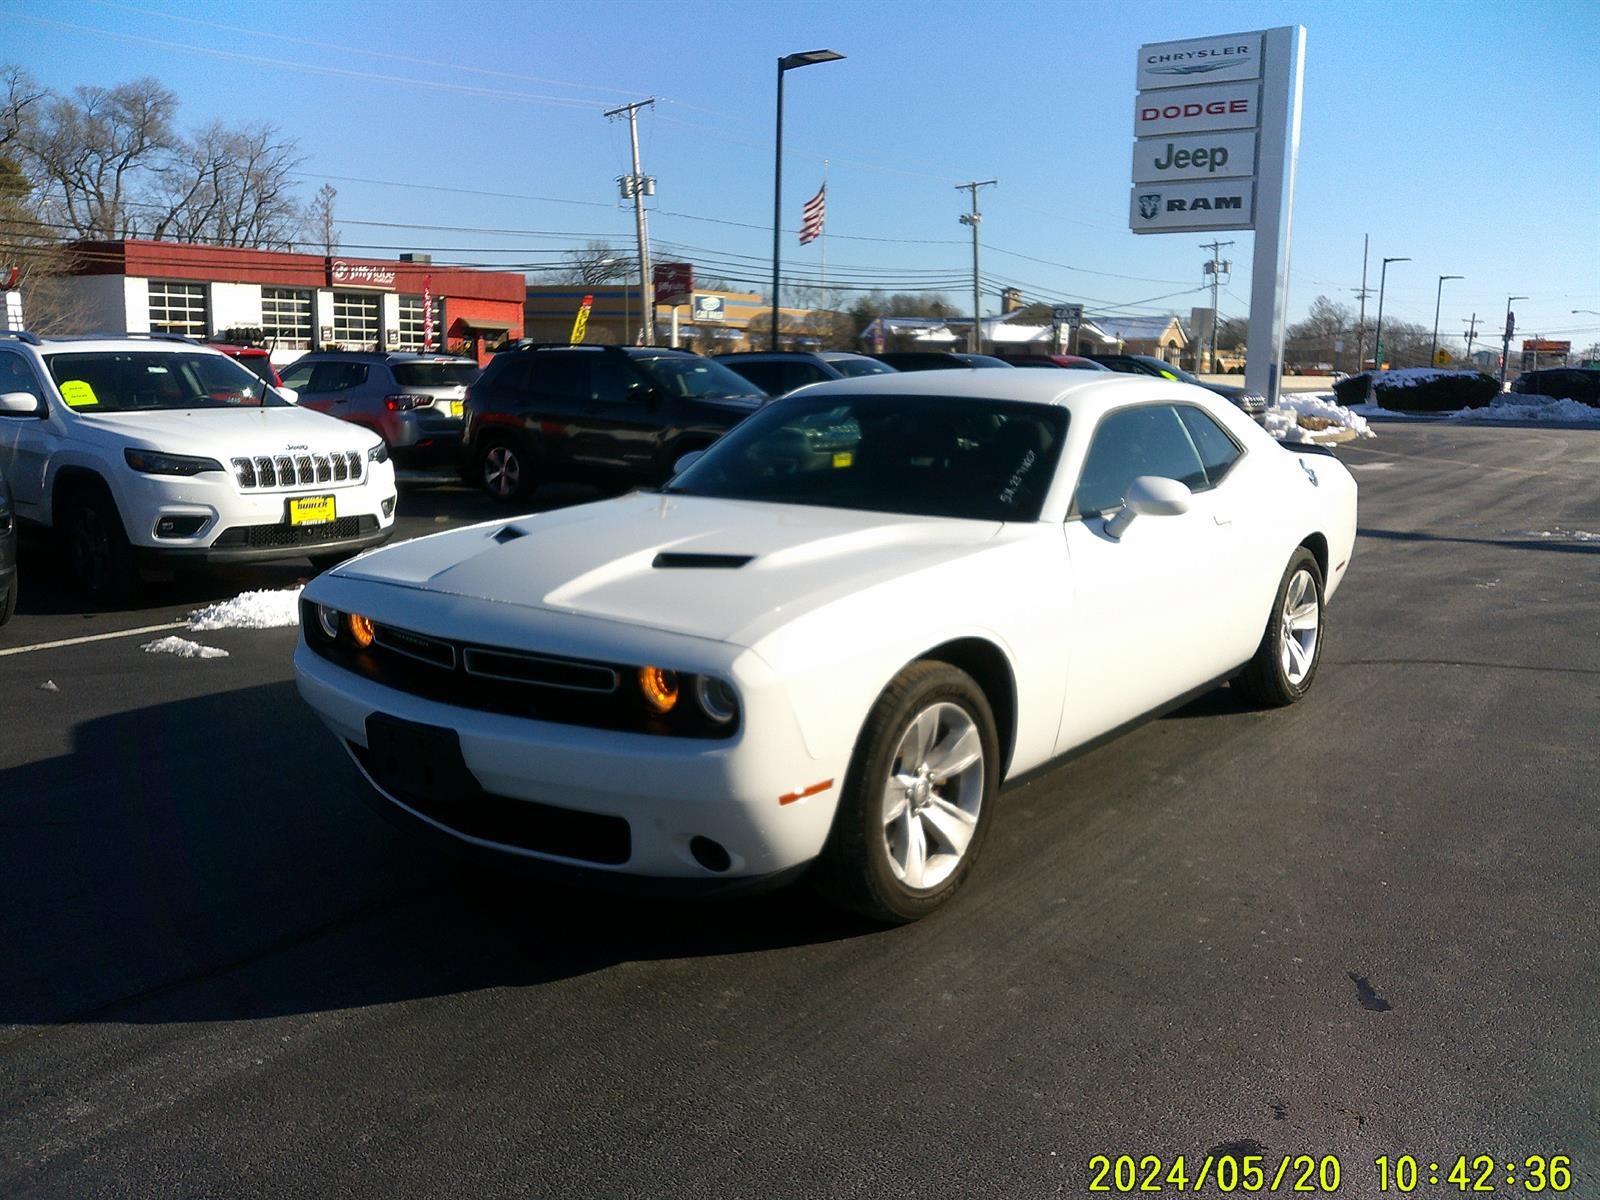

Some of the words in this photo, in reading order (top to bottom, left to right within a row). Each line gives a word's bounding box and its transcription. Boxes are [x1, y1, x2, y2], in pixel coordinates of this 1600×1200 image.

[1147, 46, 1249, 64] CHRYSLER
[1141, 99, 1249, 121] DODGE
[1154, 143, 1229, 172] Jeep
[1166, 196, 1243, 212] RAM
